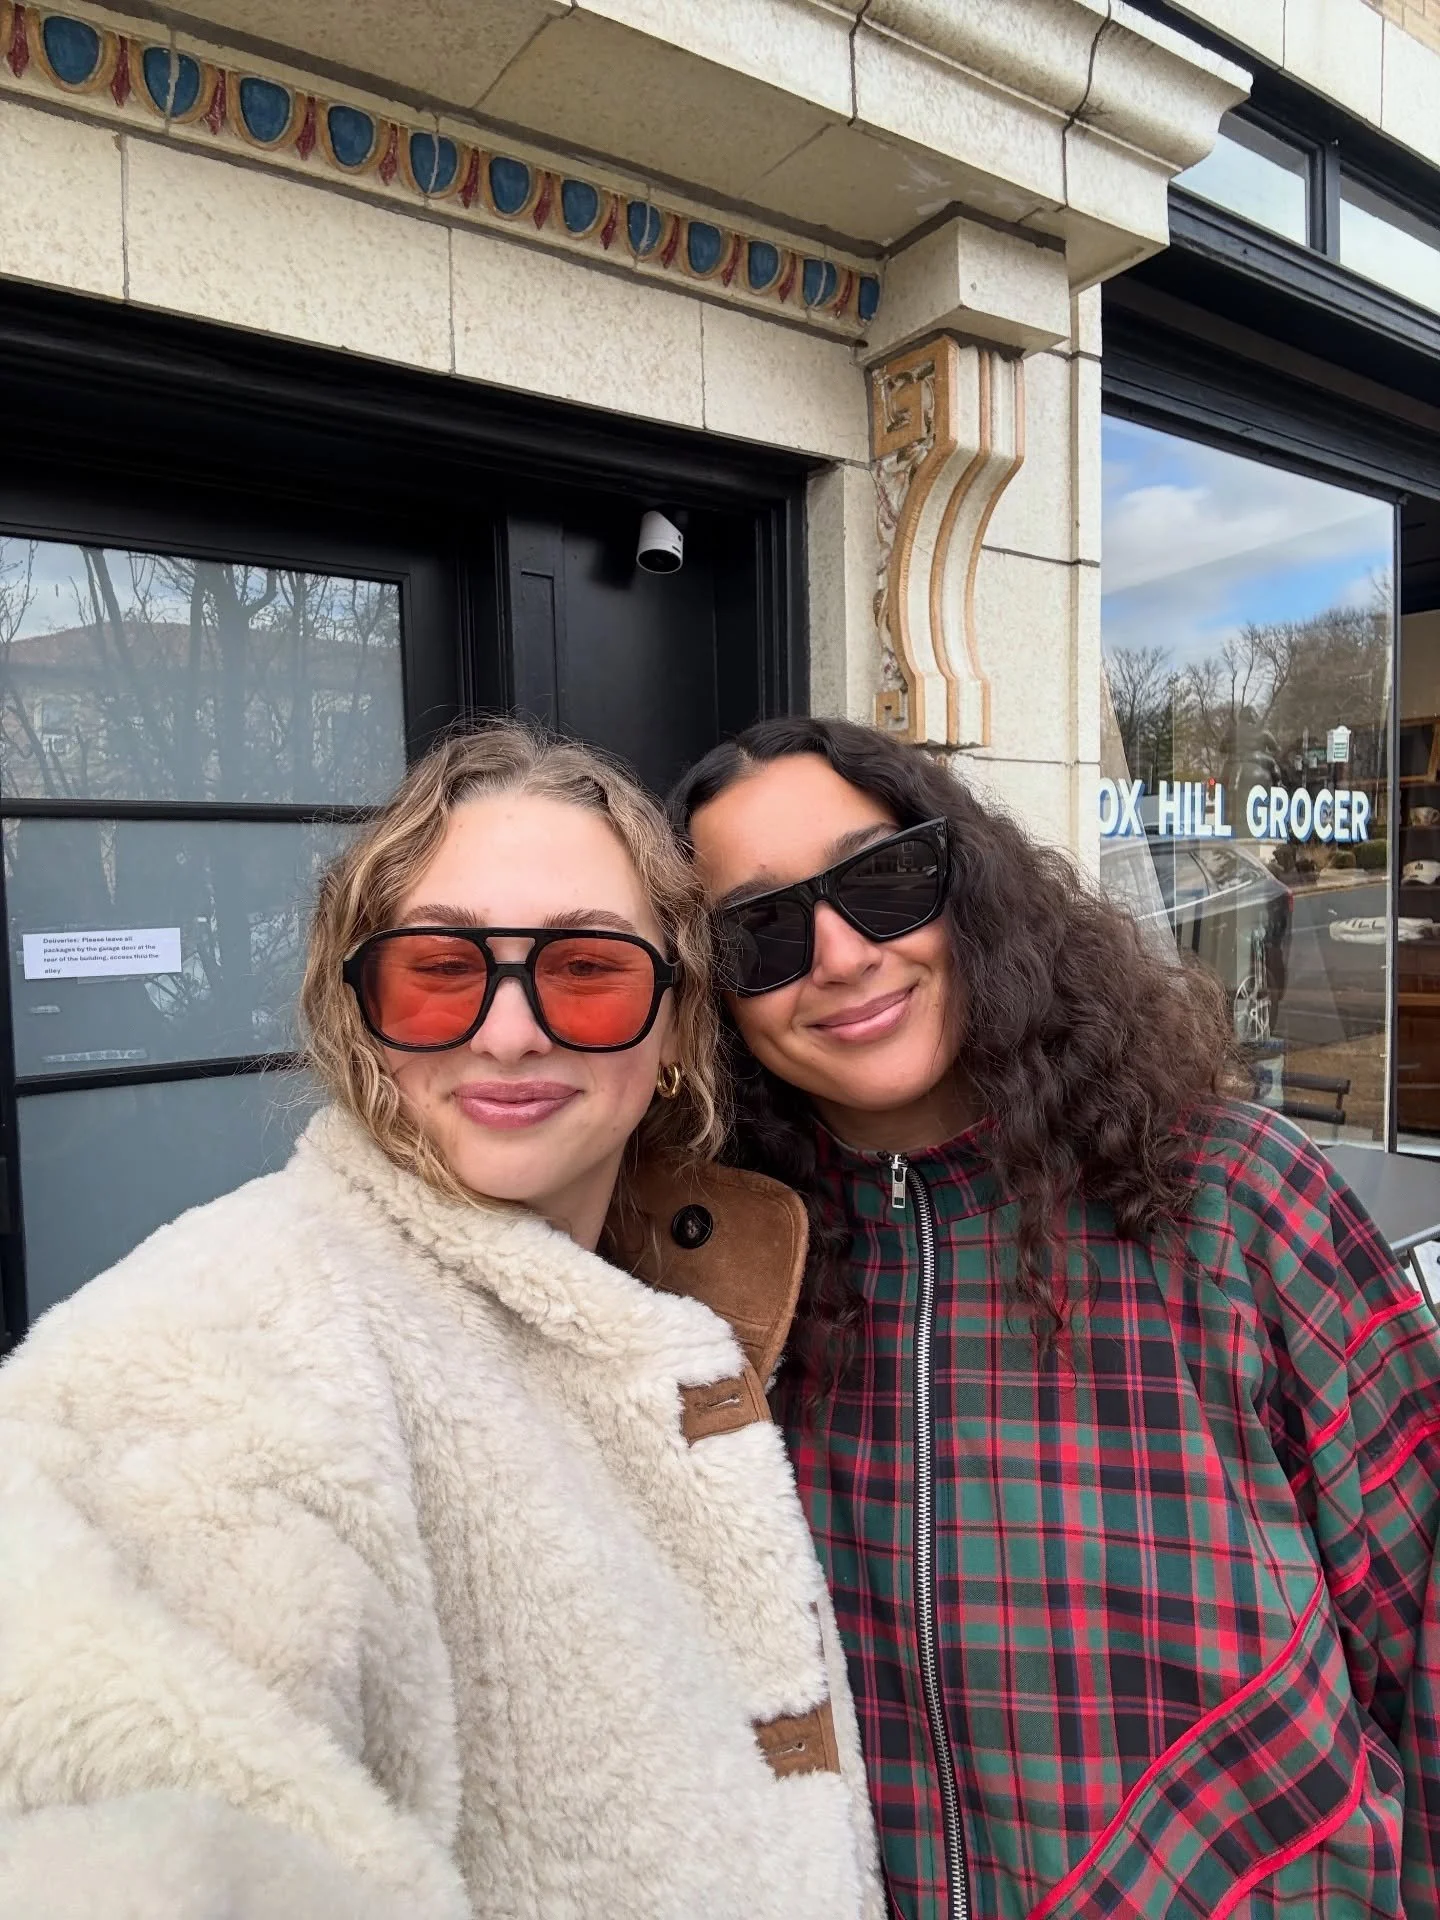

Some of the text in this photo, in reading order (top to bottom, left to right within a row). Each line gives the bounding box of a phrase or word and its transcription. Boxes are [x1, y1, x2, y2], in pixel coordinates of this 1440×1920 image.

[1097, 777, 1371, 843] OX HILL GROCER
[43, 947, 76, 955] packages
